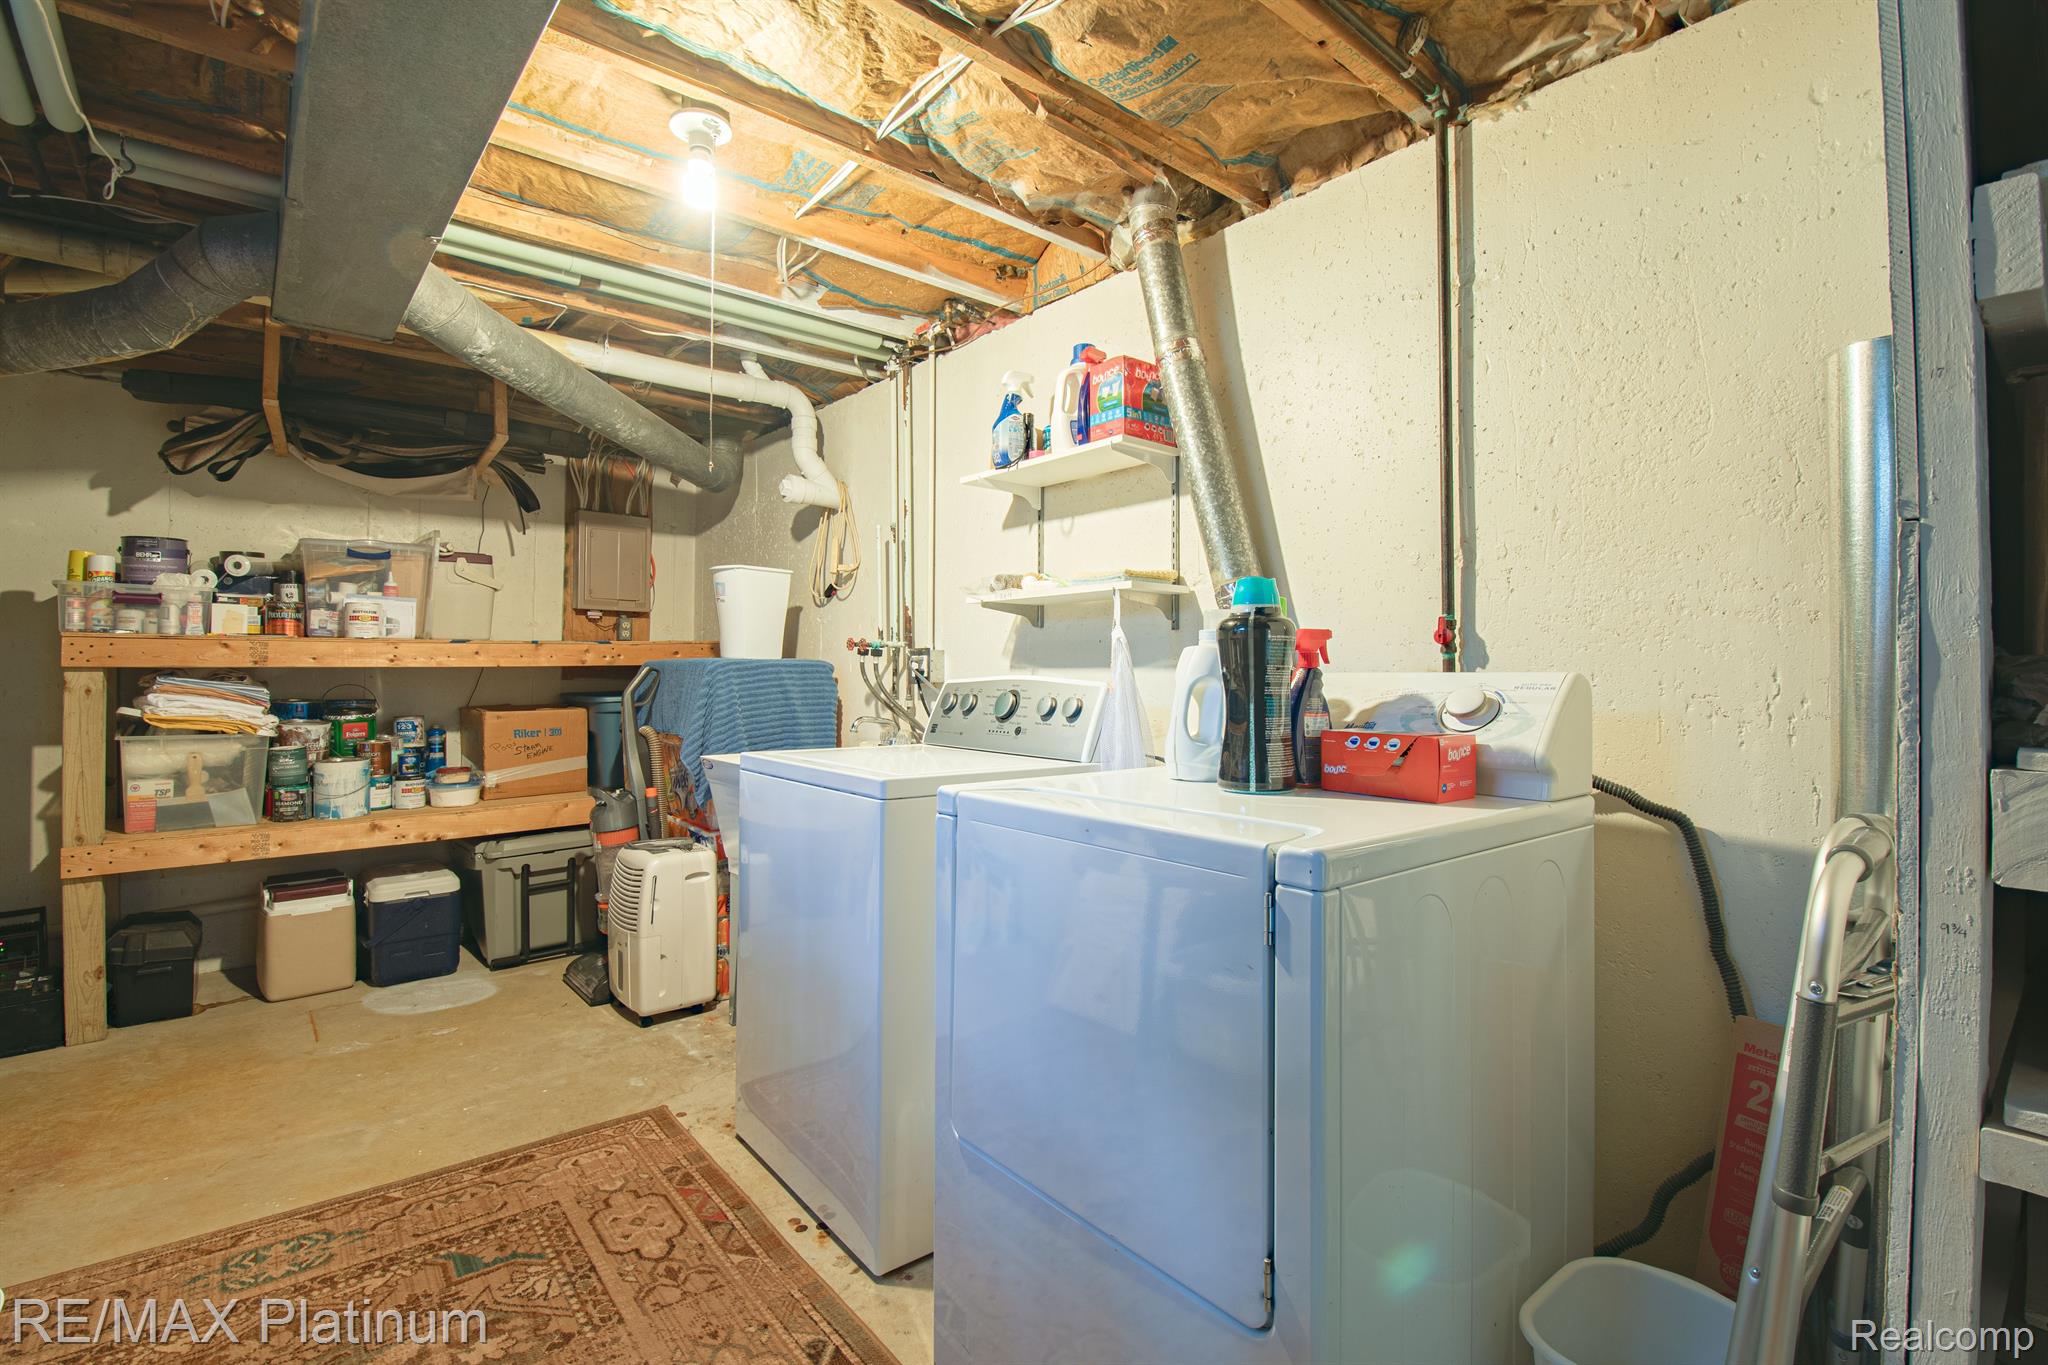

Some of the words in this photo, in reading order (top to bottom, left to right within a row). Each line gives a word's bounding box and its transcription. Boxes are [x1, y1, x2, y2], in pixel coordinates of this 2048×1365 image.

[1092, 366, 1120, 385] bounce
[513, 729, 541, 738] Riker
[1447, 745, 1471, 762] bounce
[154, 788, 171, 796] TSP
